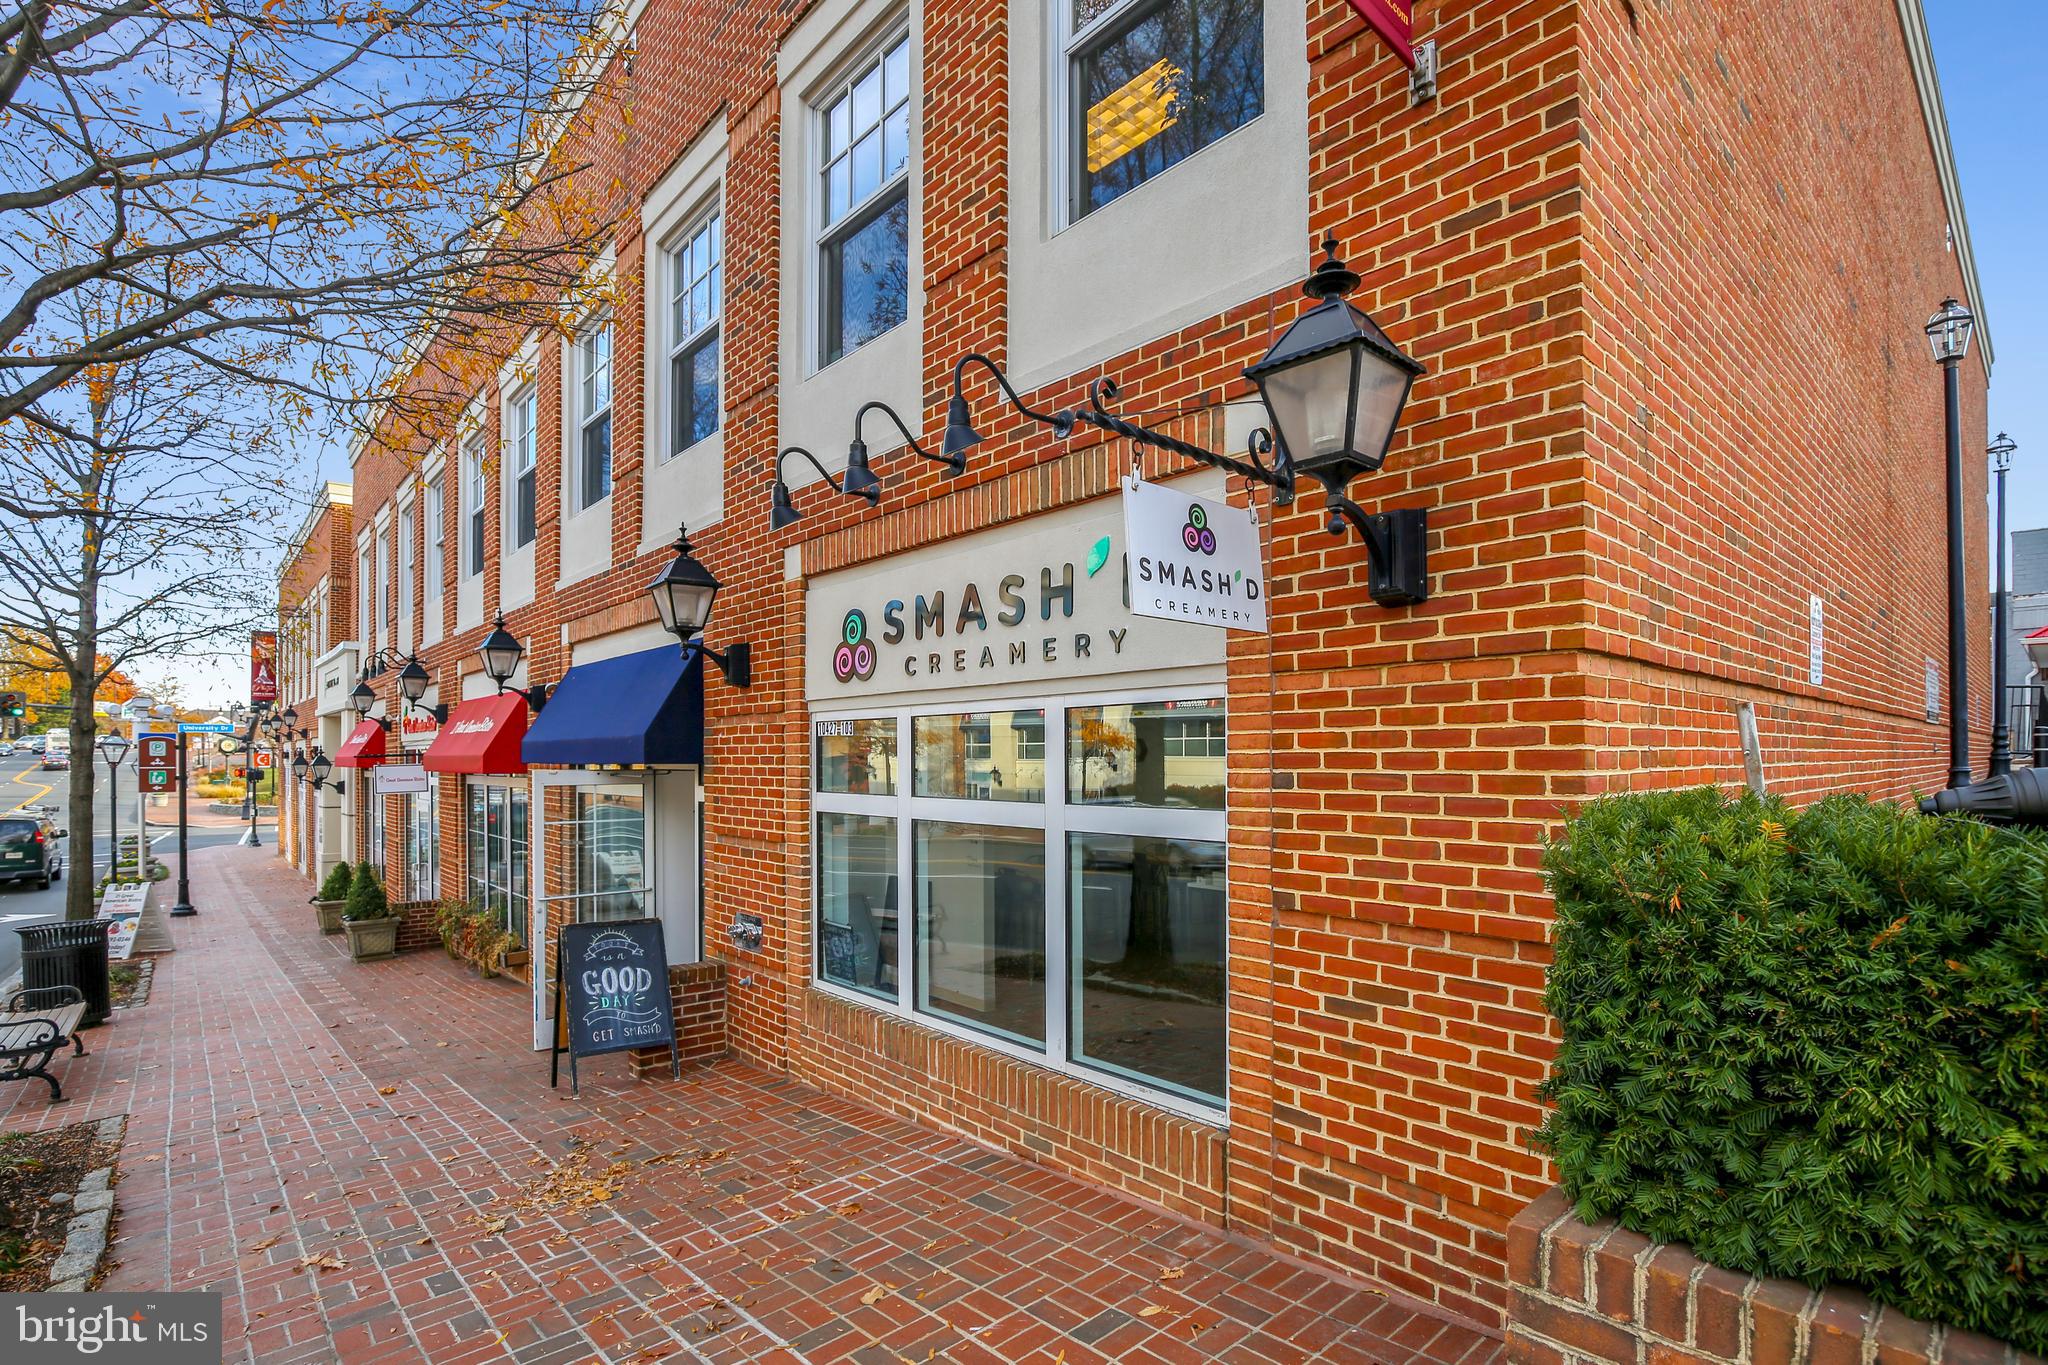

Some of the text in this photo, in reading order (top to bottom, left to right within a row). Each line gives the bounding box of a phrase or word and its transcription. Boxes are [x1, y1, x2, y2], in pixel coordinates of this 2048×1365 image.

[883, 535, 1131, 645] SMASH'
[1139, 557, 1259, 600] SMASH'D
[1155, 598, 1251, 622] CREAMERY
[904, 628, 1127, 676] CREAMERY
[581, 966, 652, 995] GOOD
[601, 994, 630, 1008] DAY
[592, 1028, 614, 1042] GET
